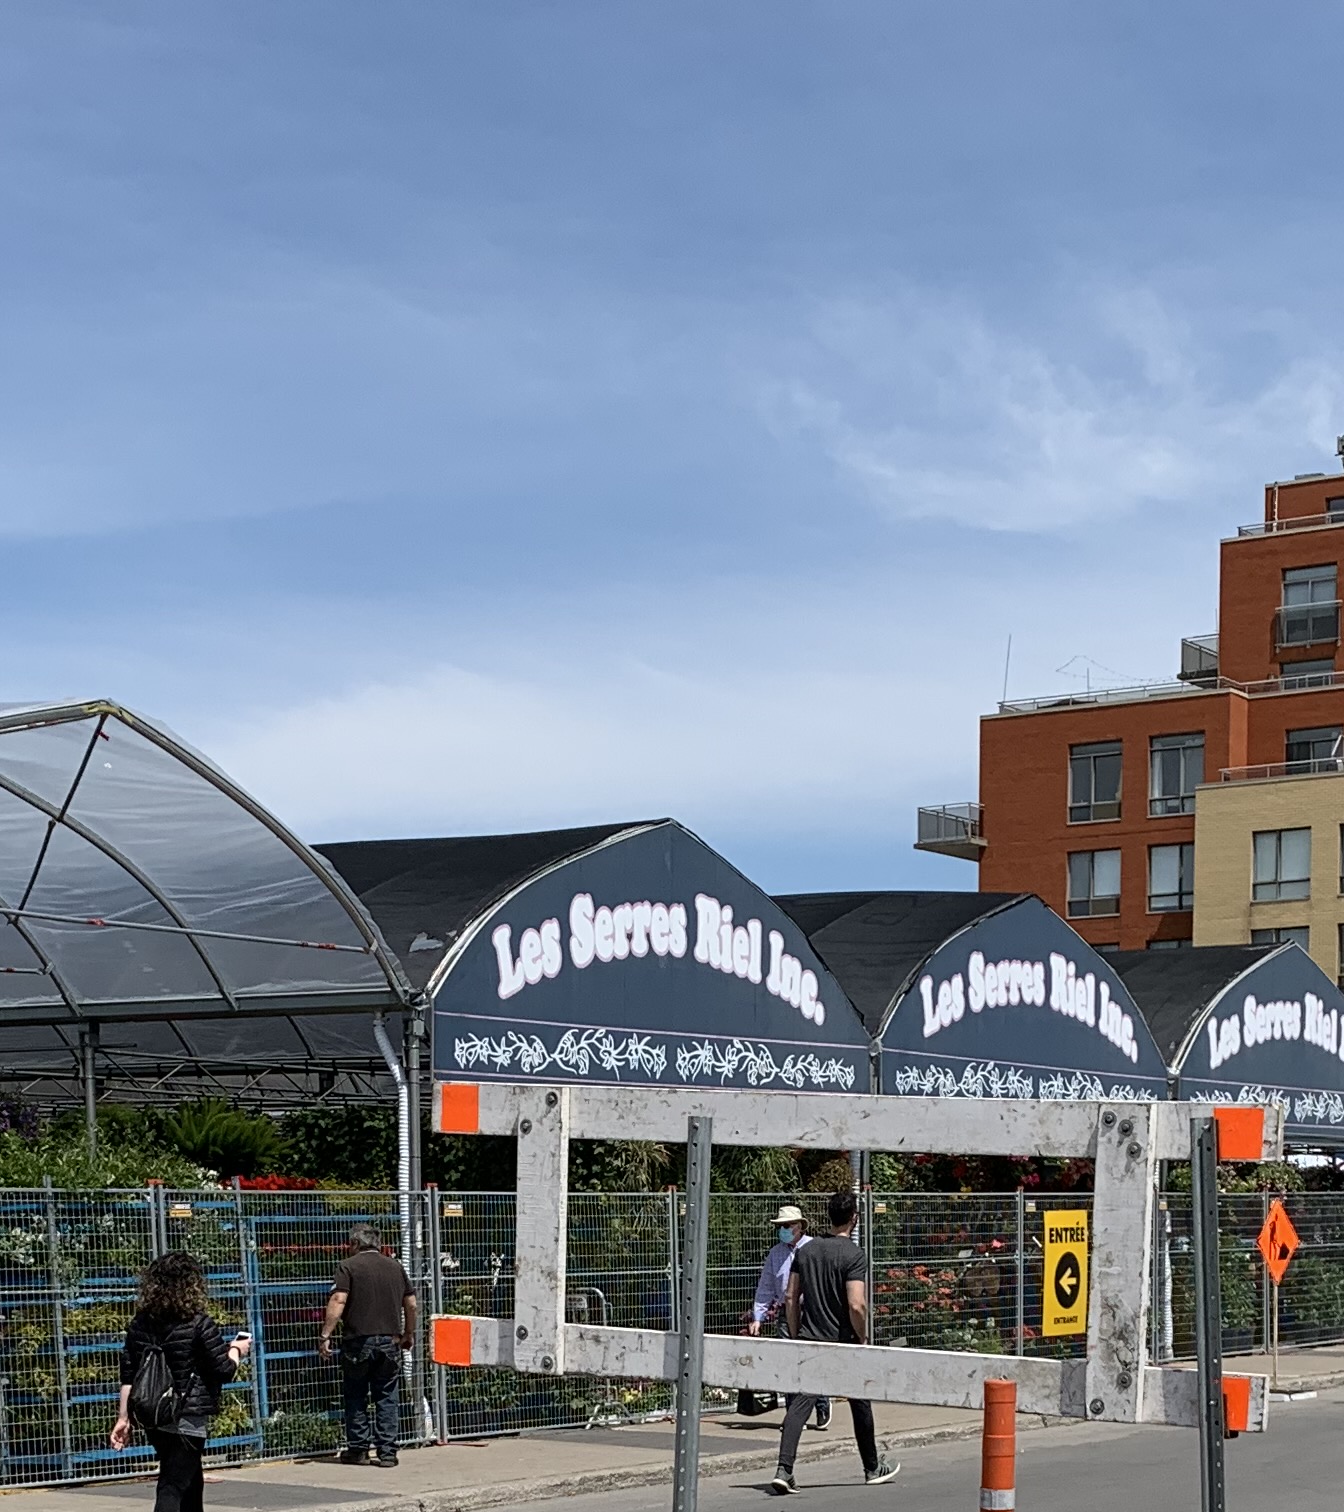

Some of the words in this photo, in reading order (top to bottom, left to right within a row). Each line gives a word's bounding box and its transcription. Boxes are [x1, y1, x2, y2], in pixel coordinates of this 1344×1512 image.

[492, 923, 562, 999] Les
[569, 893, 688, 969] Serres
[694, 893, 762, 984] Riel
[766, 930, 825, 1026] Inc.
[919, 973, 965, 1038] Les
[968, 951, 1045, 1013] Serres
[1050, 951, 1095, 1027] Riel
[1099, 981, 1138, 1064] Inc.
[1208, 1014, 1241, 1070] Les
[1243, 994, 1301, 1048] Serres
[1304, 992, 1338, 1055] Riel
[1049, 1221, 1085, 1243] ENTRÉE
